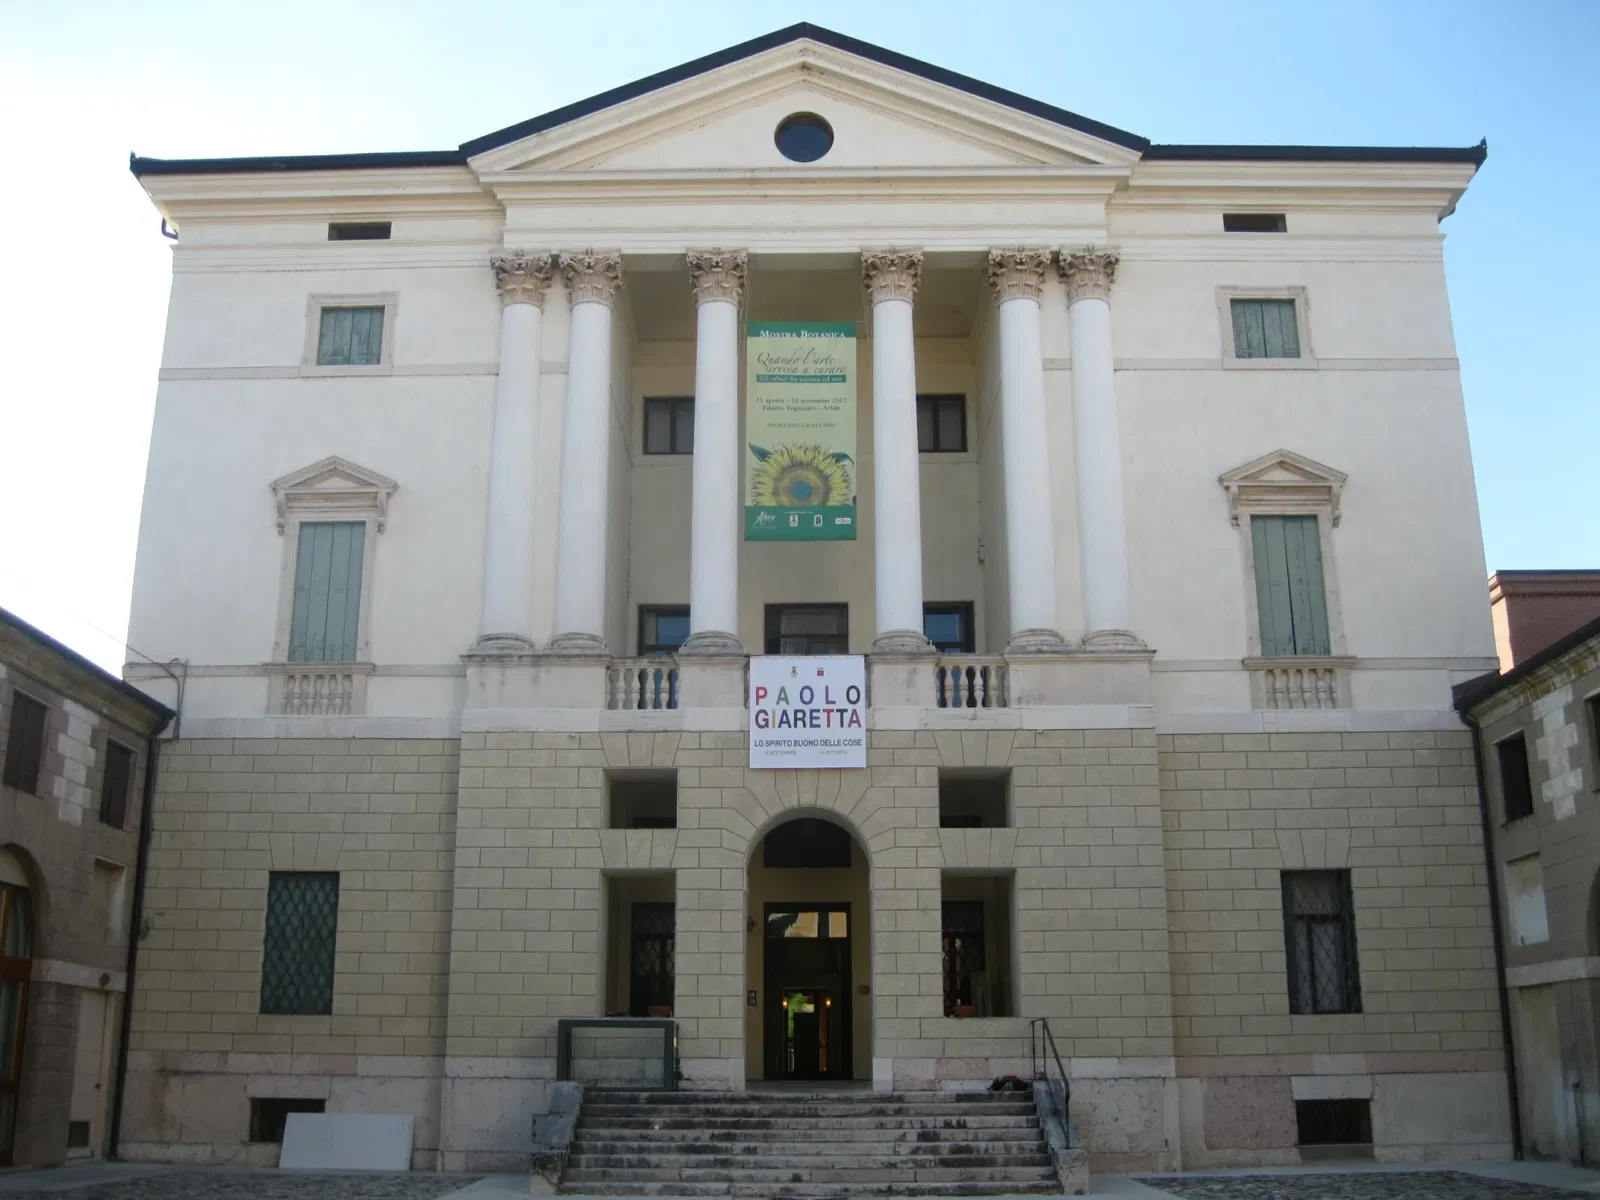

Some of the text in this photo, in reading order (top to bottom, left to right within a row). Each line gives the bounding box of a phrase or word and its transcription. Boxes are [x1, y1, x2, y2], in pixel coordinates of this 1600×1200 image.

[757, 346, 802, 366] Quando
[755, 685, 861, 705] PAOLO
[755, 709, 862, 729] GIARETTA
